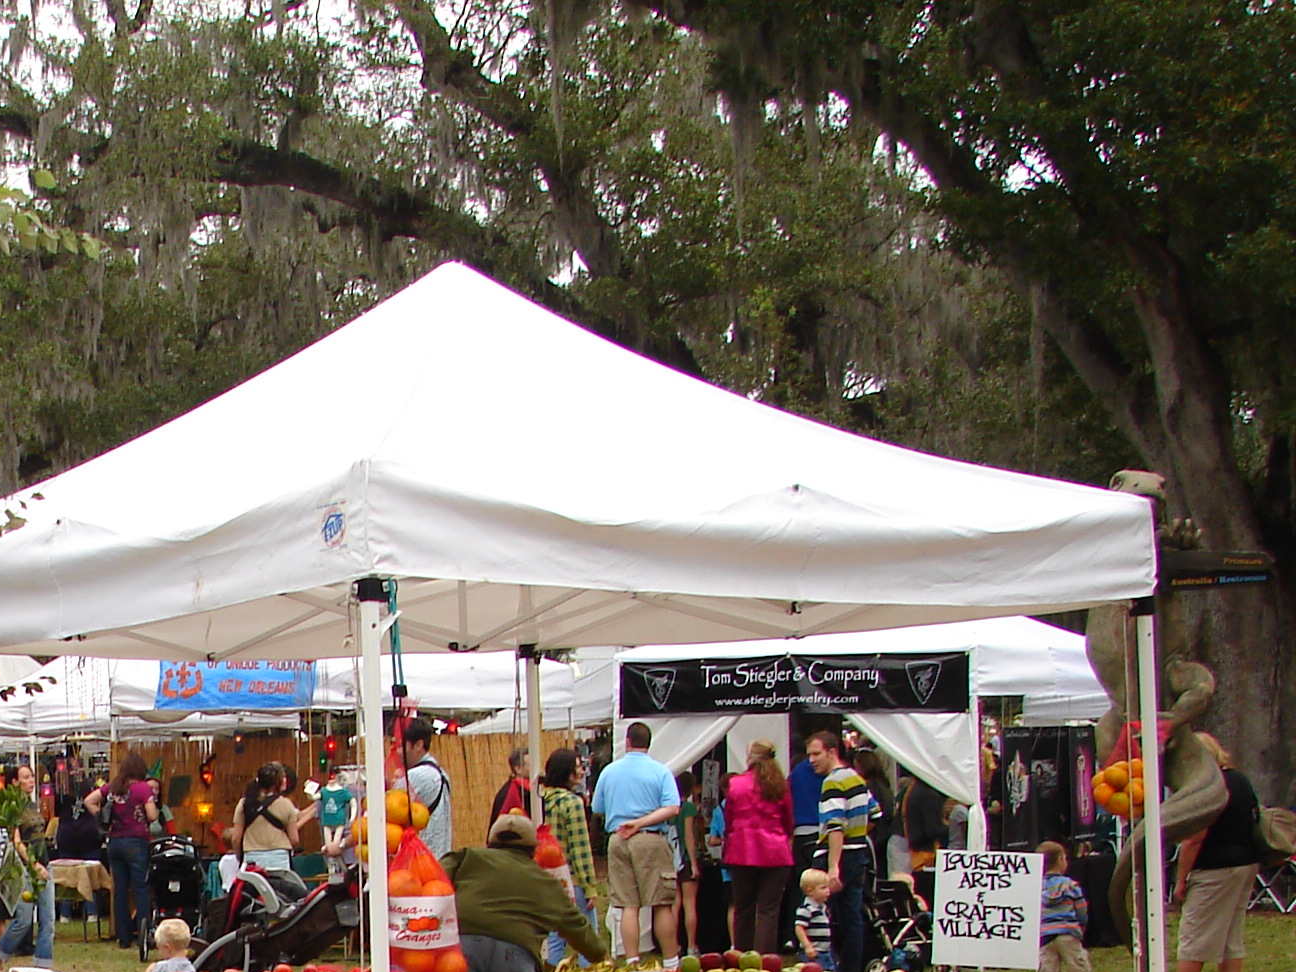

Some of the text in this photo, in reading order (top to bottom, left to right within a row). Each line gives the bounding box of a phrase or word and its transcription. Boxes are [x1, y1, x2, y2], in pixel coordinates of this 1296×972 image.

[1170, 577, 1213, 587] Australia
[1218, 575, 1267, 584] Restrooms
[700, 660, 880, 689] Tom Stiegler & Company
[218, 679, 295, 694] NEW ORLEANS
[714, 692, 859, 709] www.stieglerjewelry.com
[943, 852, 1030, 875] LOUISIANA
[958, 871, 1012, 891] ARTS
[944, 900, 1025, 923] CRAFTS
[396, 930, 441, 946] Oranges
[937, 919, 1022, 941] VILLAGE
